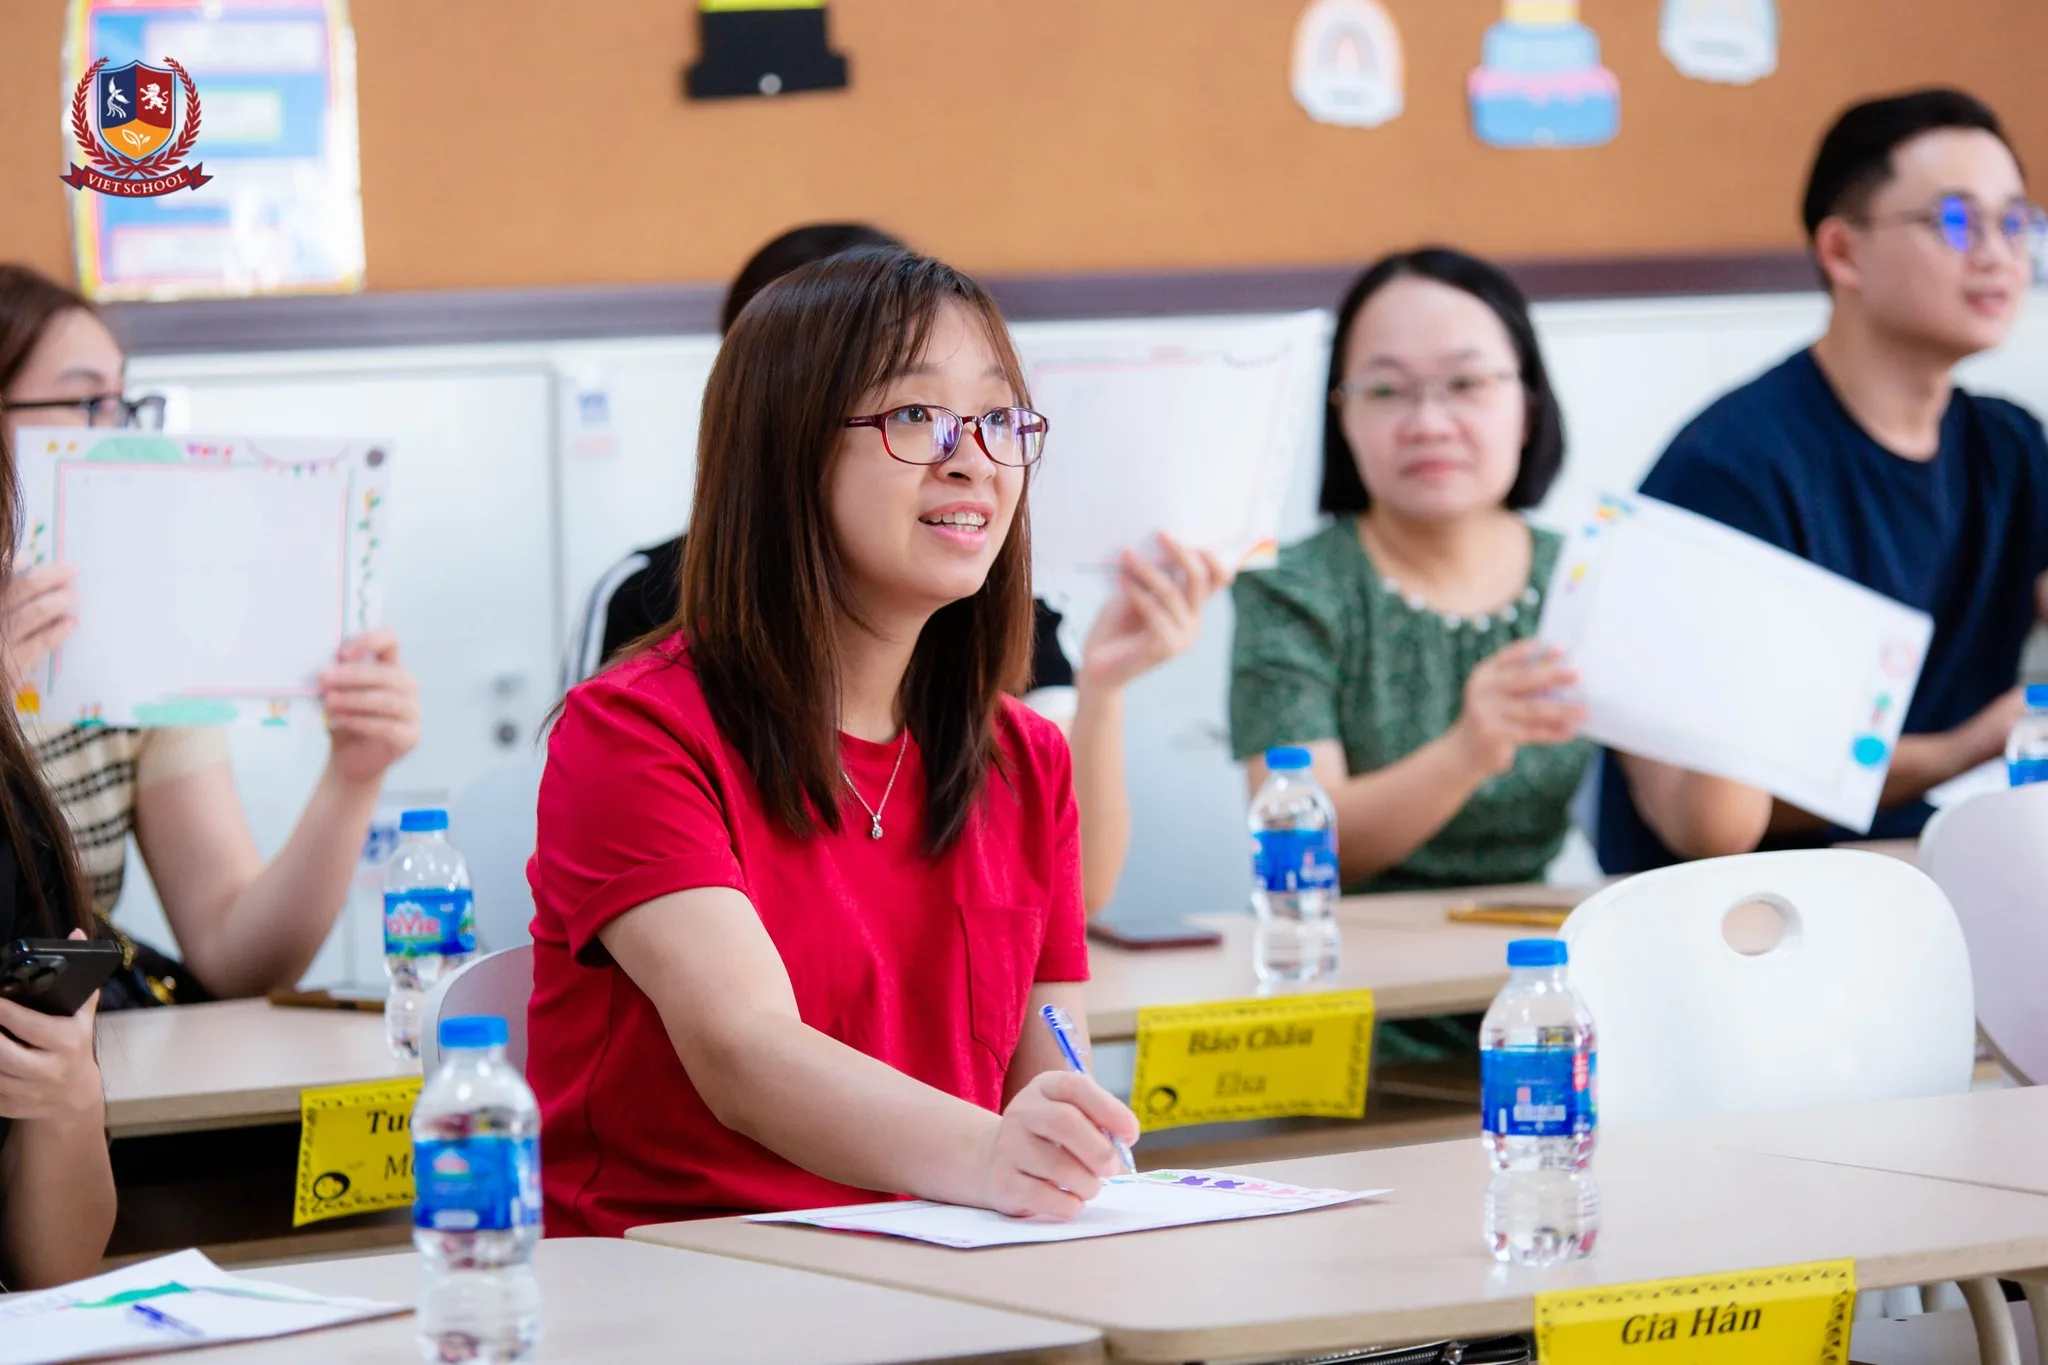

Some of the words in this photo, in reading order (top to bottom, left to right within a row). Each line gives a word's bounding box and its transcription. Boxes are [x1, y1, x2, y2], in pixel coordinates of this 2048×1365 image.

[366, 1109, 401, 1134] Tu
[1620, 1313, 1679, 1345] Gia
[1689, 1302, 1763, 1337] Hân
